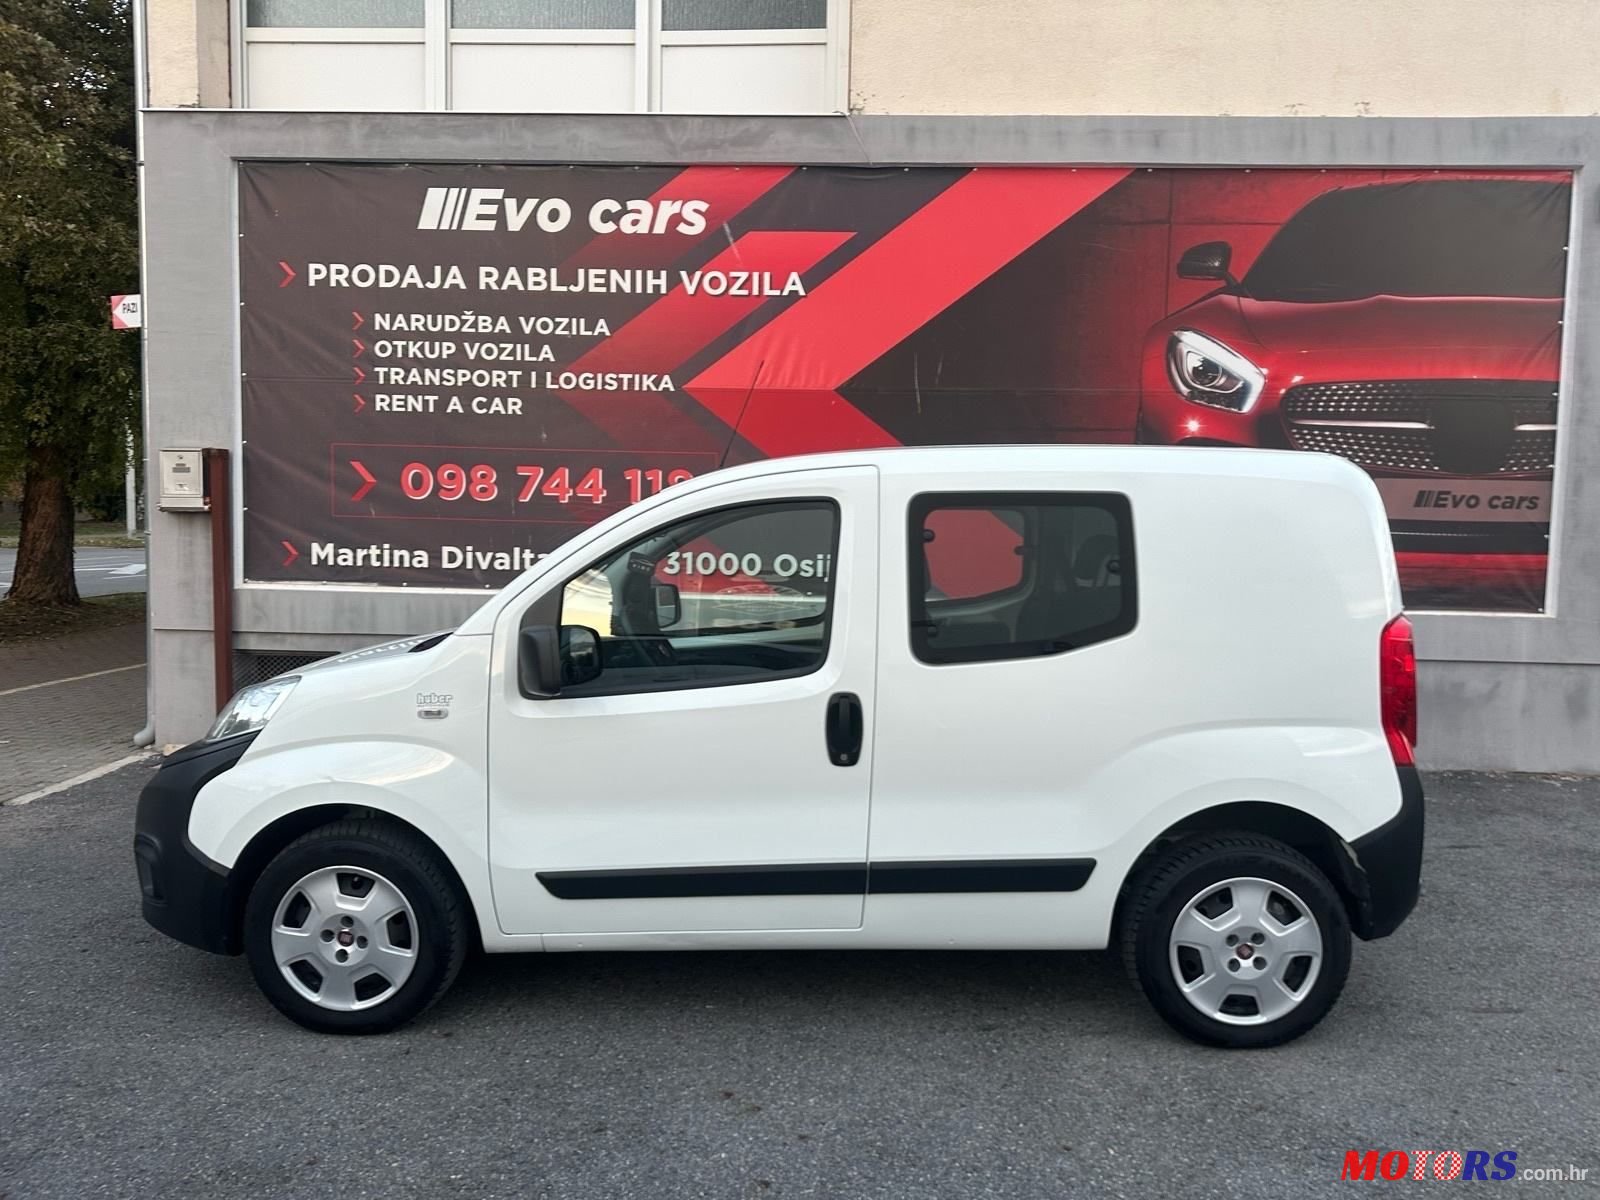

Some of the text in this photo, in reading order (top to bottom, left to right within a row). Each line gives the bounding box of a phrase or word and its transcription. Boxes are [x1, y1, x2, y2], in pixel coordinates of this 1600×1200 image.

[461, 188, 710, 236] Evo cars
[307, 263, 806, 298] PRODAJA RABLJENIH VOZILA
[122, 302, 138, 313] PAZI
[374, 310, 611, 337] NARUDŽBA VOZILA
[374, 341, 555, 363] OTKUP VOZILA
[374, 368, 522, 389] TRANSPORT
[545, 373, 676, 394] LOGISTIKA
[374, 395, 523, 416] RENT A CAR
[400, 463, 499, 503] 098
[516, 466, 607, 504] 744
[1433, 491, 1540, 510] Evo cars
[311, 543, 430, 570] Martina
[663, 552, 762, 576] 31000
[416, 692, 454, 705] huber
